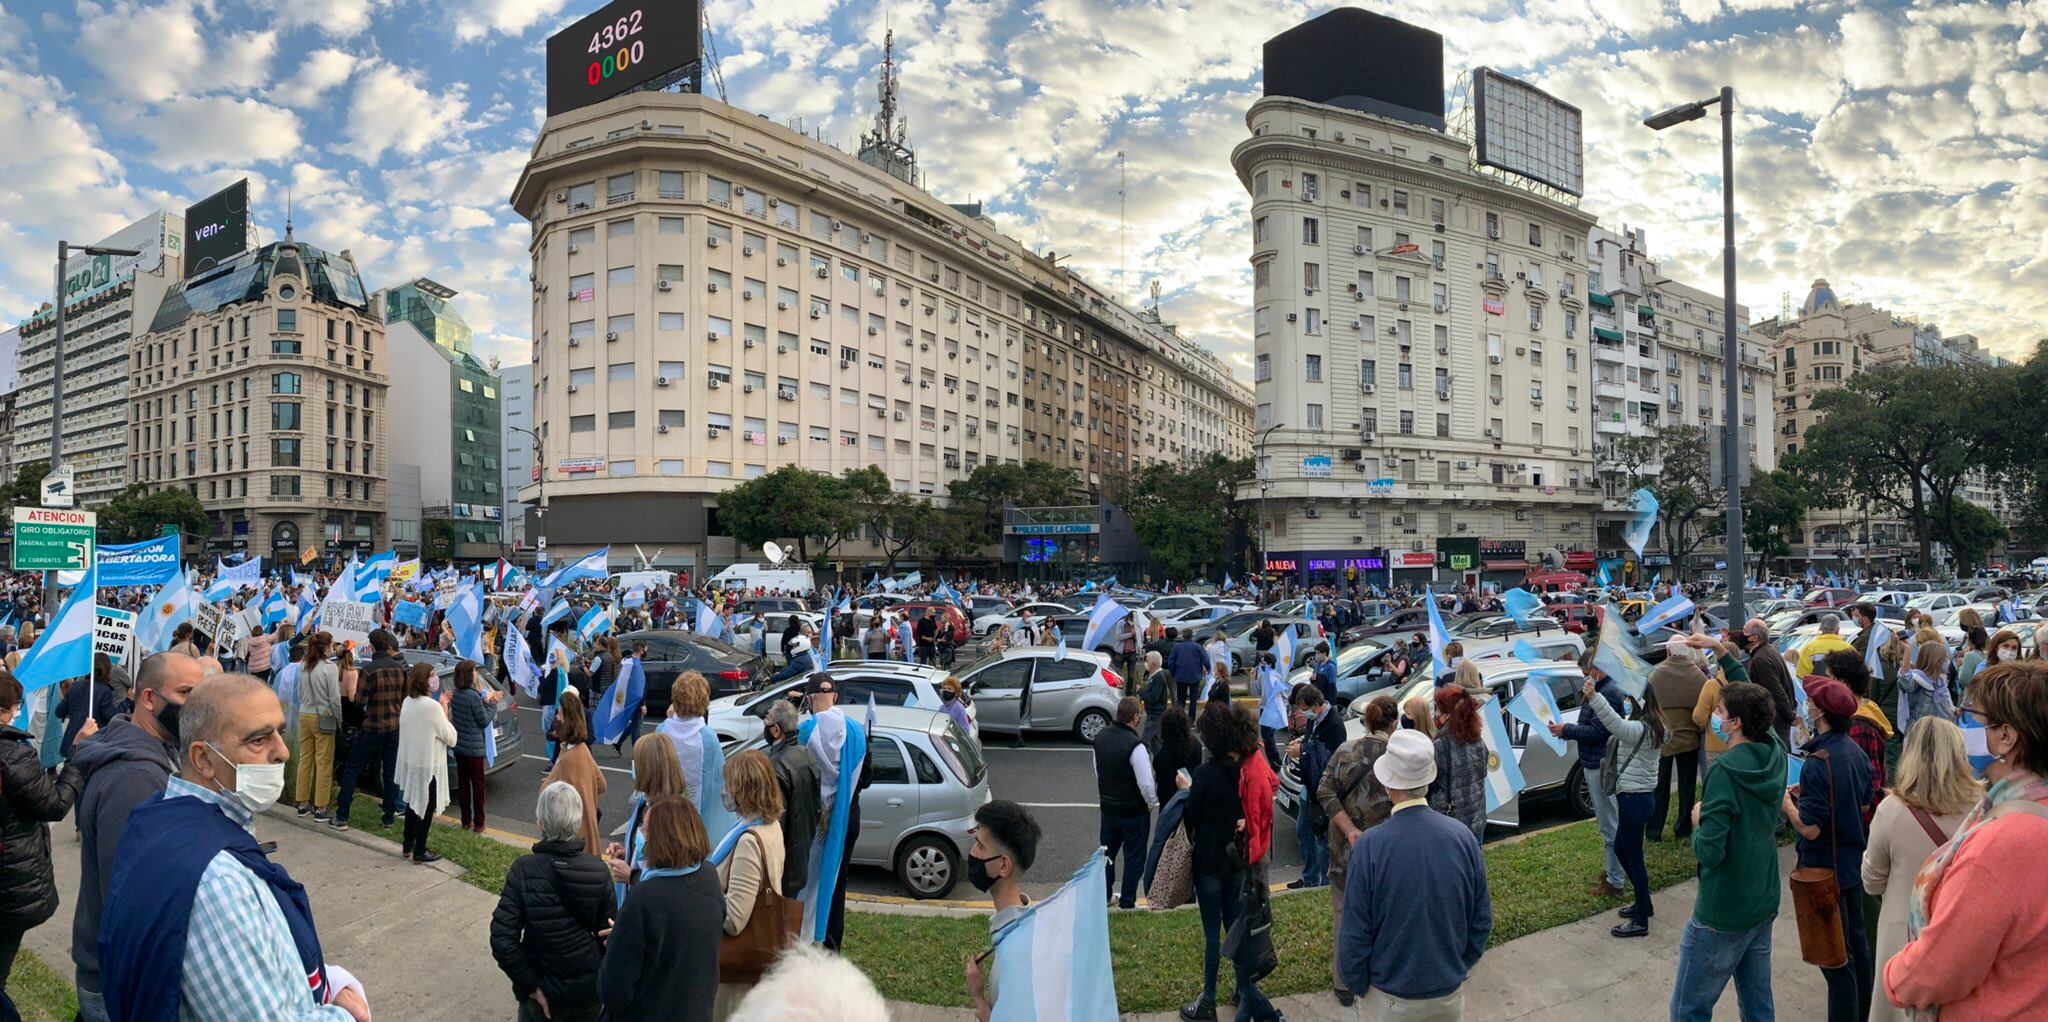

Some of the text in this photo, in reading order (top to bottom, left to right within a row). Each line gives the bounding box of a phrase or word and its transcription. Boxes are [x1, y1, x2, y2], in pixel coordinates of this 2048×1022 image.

[588, 9, 643, 54] 4362
[588, 40, 644, 86] 0000
[28, 511, 85, 523] ATENCION
[21, 526, 41, 534] GIRO
[42, 527, 91, 536] OBLIGATORIO
[1045, 525, 1055, 533] DE
[1266, 560, 1296, 570] LA NUEVA
[1453, 556, 1468, 564] Mel
[97, 615, 130, 629] TA de
[95, 629, 127, 642] ICOS
[95, 642, 123, 654] NSAN
